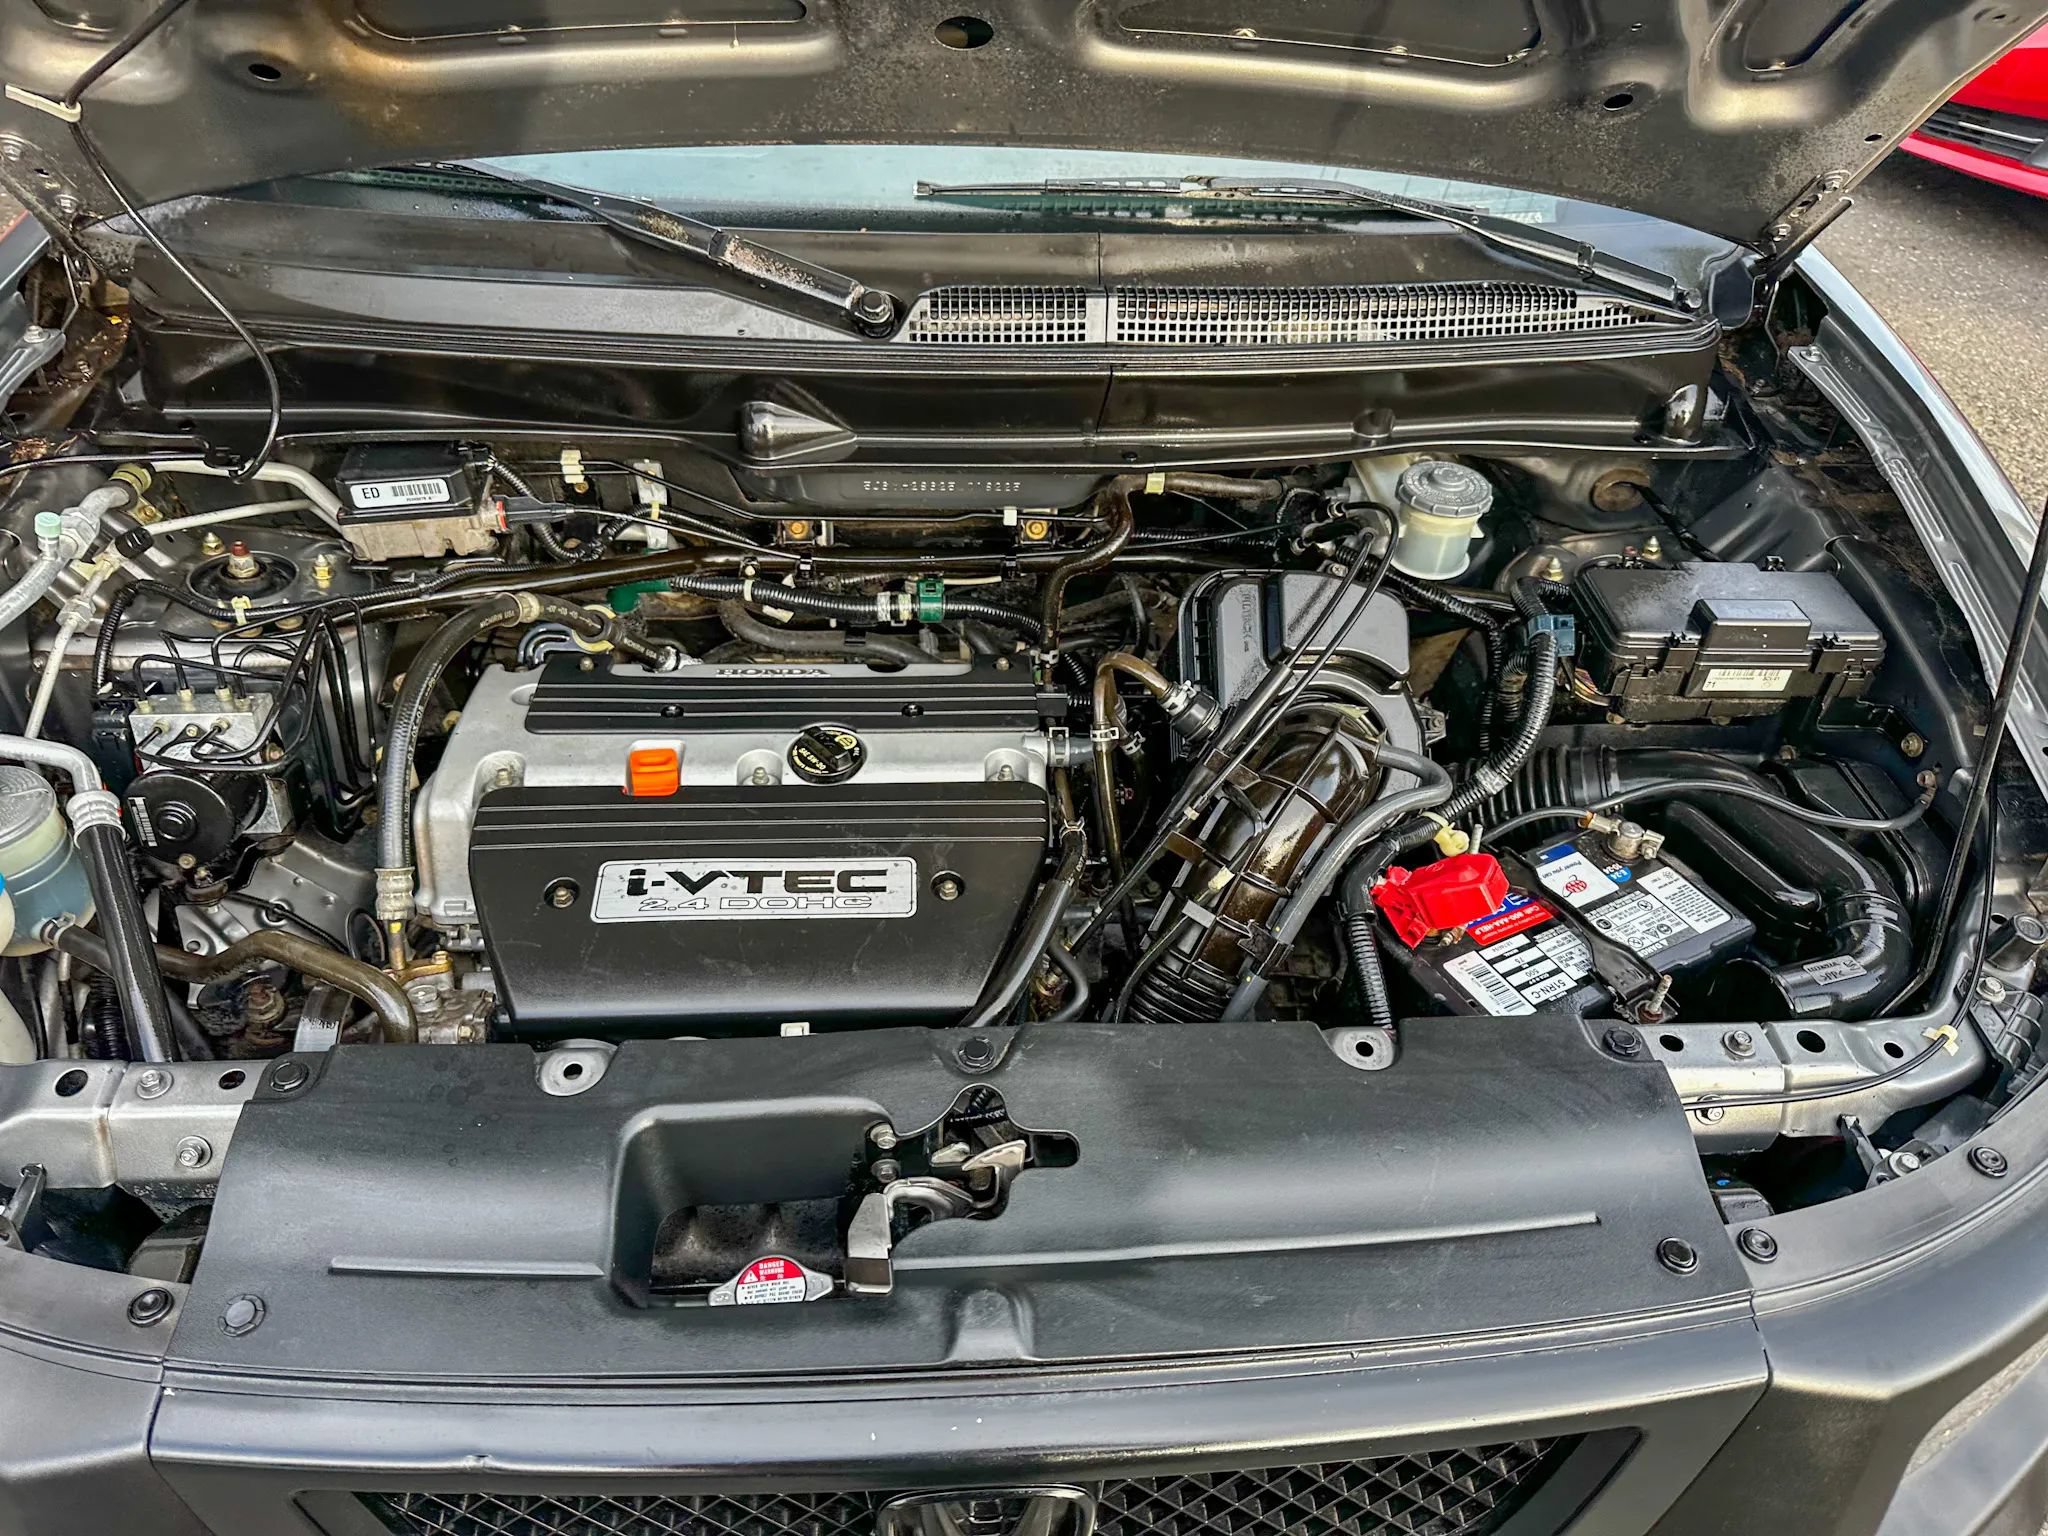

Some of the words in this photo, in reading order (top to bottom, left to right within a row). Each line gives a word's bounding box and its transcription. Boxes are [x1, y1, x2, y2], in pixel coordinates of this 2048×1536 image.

[361, 487, 380, 499] ED
[505, 610, 515, 619] USA
[717, 668, 830, 678] HONDA
[798, 747, 811, 757] SAE
[807, 754, 826, 770] 5W-20
[1552, 866, 1563, 875] you
[1564, 860, 1582, 872] Power
[1541, 871, 1552, 879] can
[626, 868, 888, 896] i-VTEC
[639, 897, 709, 912] 2.4
[720, 896, 872, 910] DOHC
[1525, 968, 1540, 977] 500
[1530, 979, 1567, 999] 51RN-C
[759, 1260, 785, 1270] DANGER
[759, 1268, 785, 1276] WARNING
